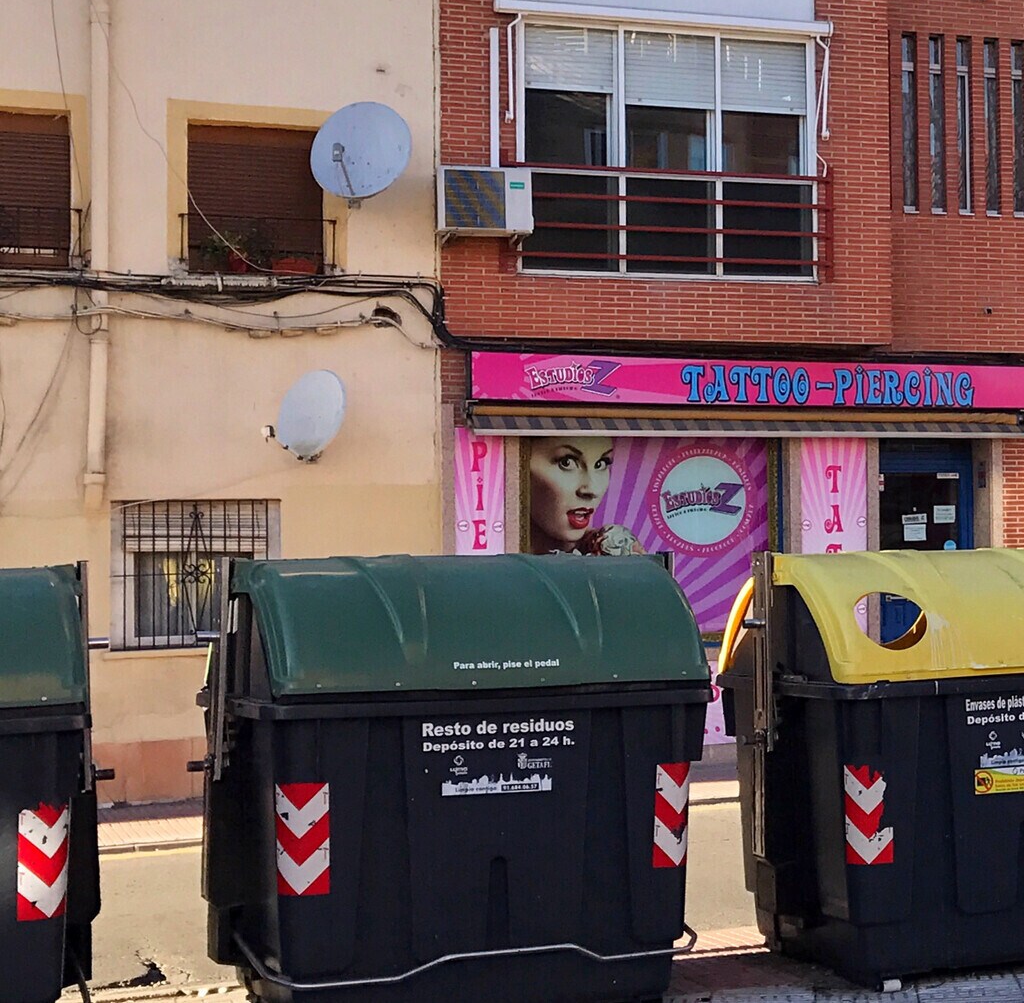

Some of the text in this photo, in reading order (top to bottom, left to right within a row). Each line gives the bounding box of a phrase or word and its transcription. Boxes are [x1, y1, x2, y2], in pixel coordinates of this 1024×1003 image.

[453, 659, 560, 671] Para abrir, pise el pedal
[965, 698, 995, 712] Envases
[997, 696, 1006, 709] de
[422, 718, 575, 737] Resto de residuos
[967, 714, 1016, 726] Depósito
[422, 735, 575, 753] Depósito de 21 a 24 h.
